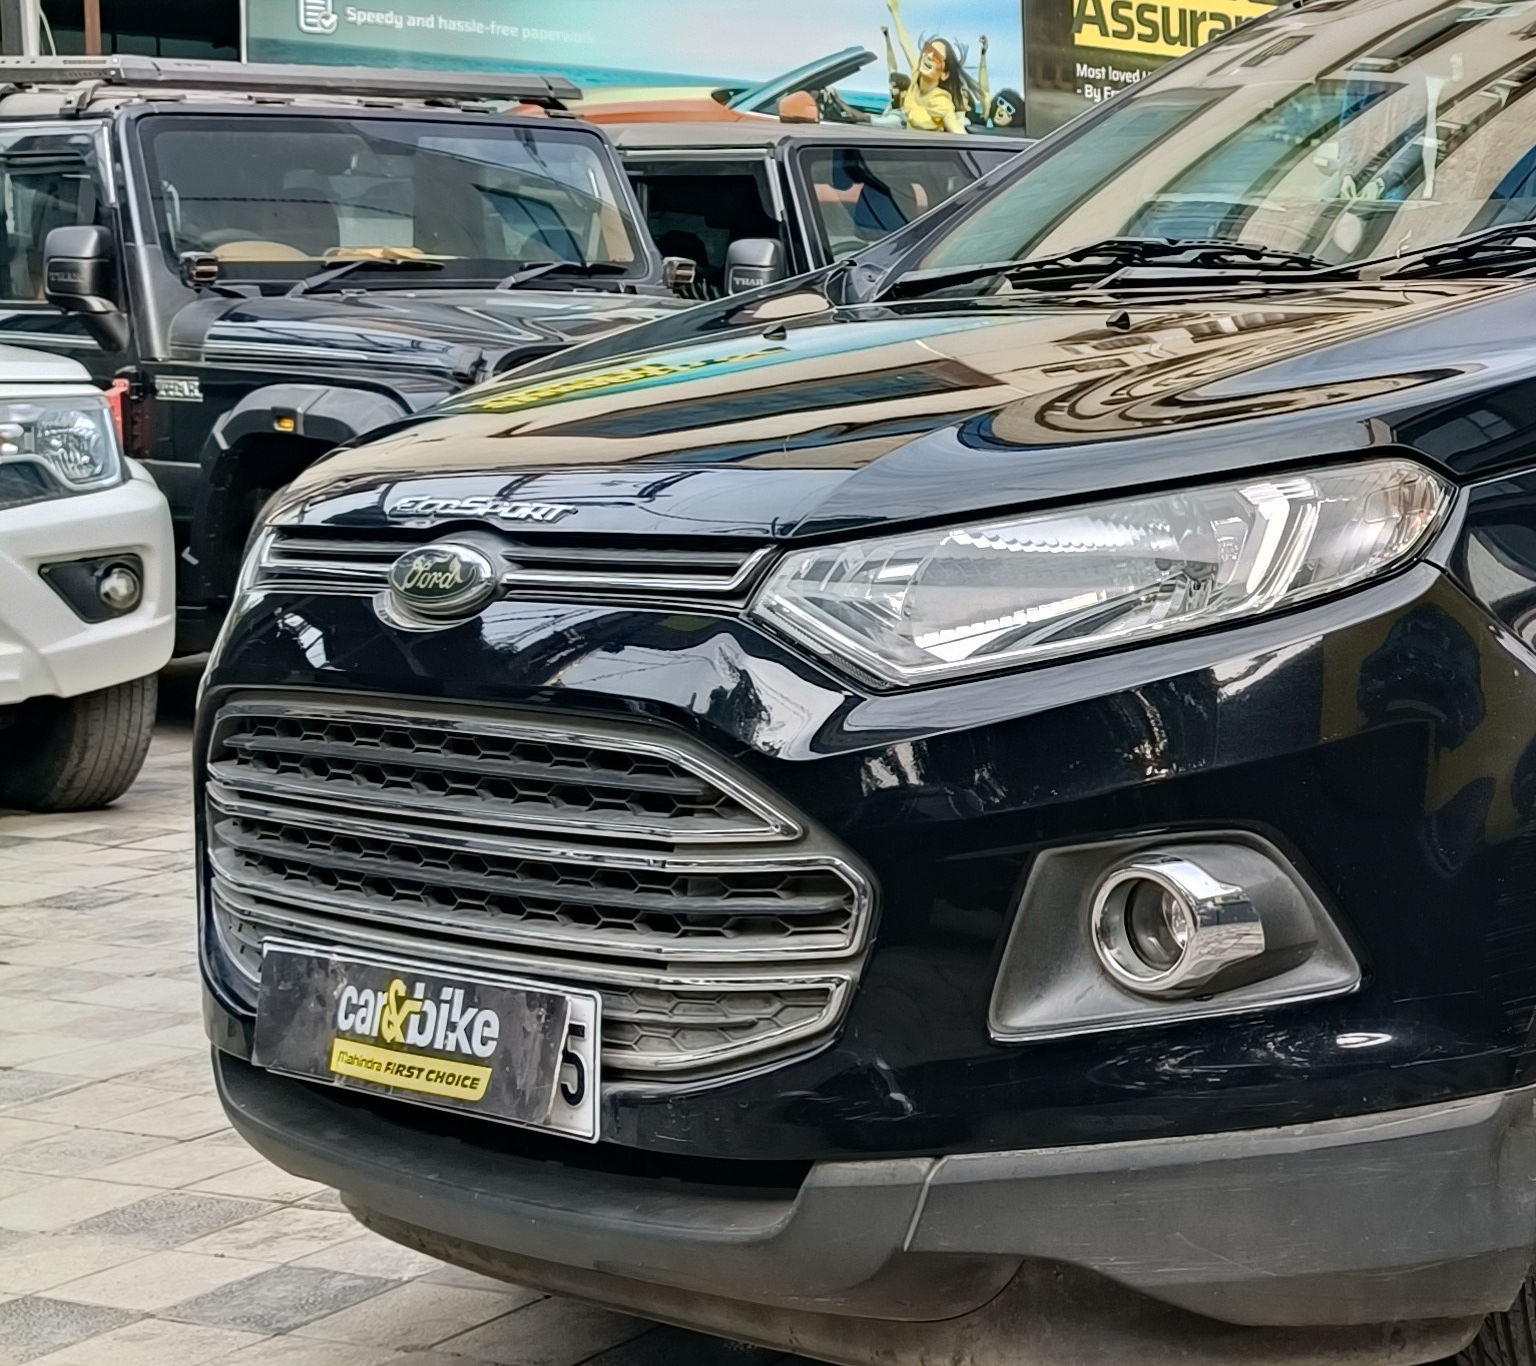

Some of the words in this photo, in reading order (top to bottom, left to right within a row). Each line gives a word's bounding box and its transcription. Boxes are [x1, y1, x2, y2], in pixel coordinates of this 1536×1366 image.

[345, 6, 403, 29] Speedy
[406, 14, 435, 30] and
[438, 15, 519, 37] hassle-free
[1076, 62, 1107, 79] Most
[1108, 65, 1140, 83] loved
[1084, 83, 1102, 103] By
[401, 552, 463, 590] Ford
[337, 978, 501, 1058] car&bike
[338, 1050, 383, 1073] Mahindra
[383, 1061, 425, 1080] FIRST
[425, 1066, 481, 1091] CHOICE
